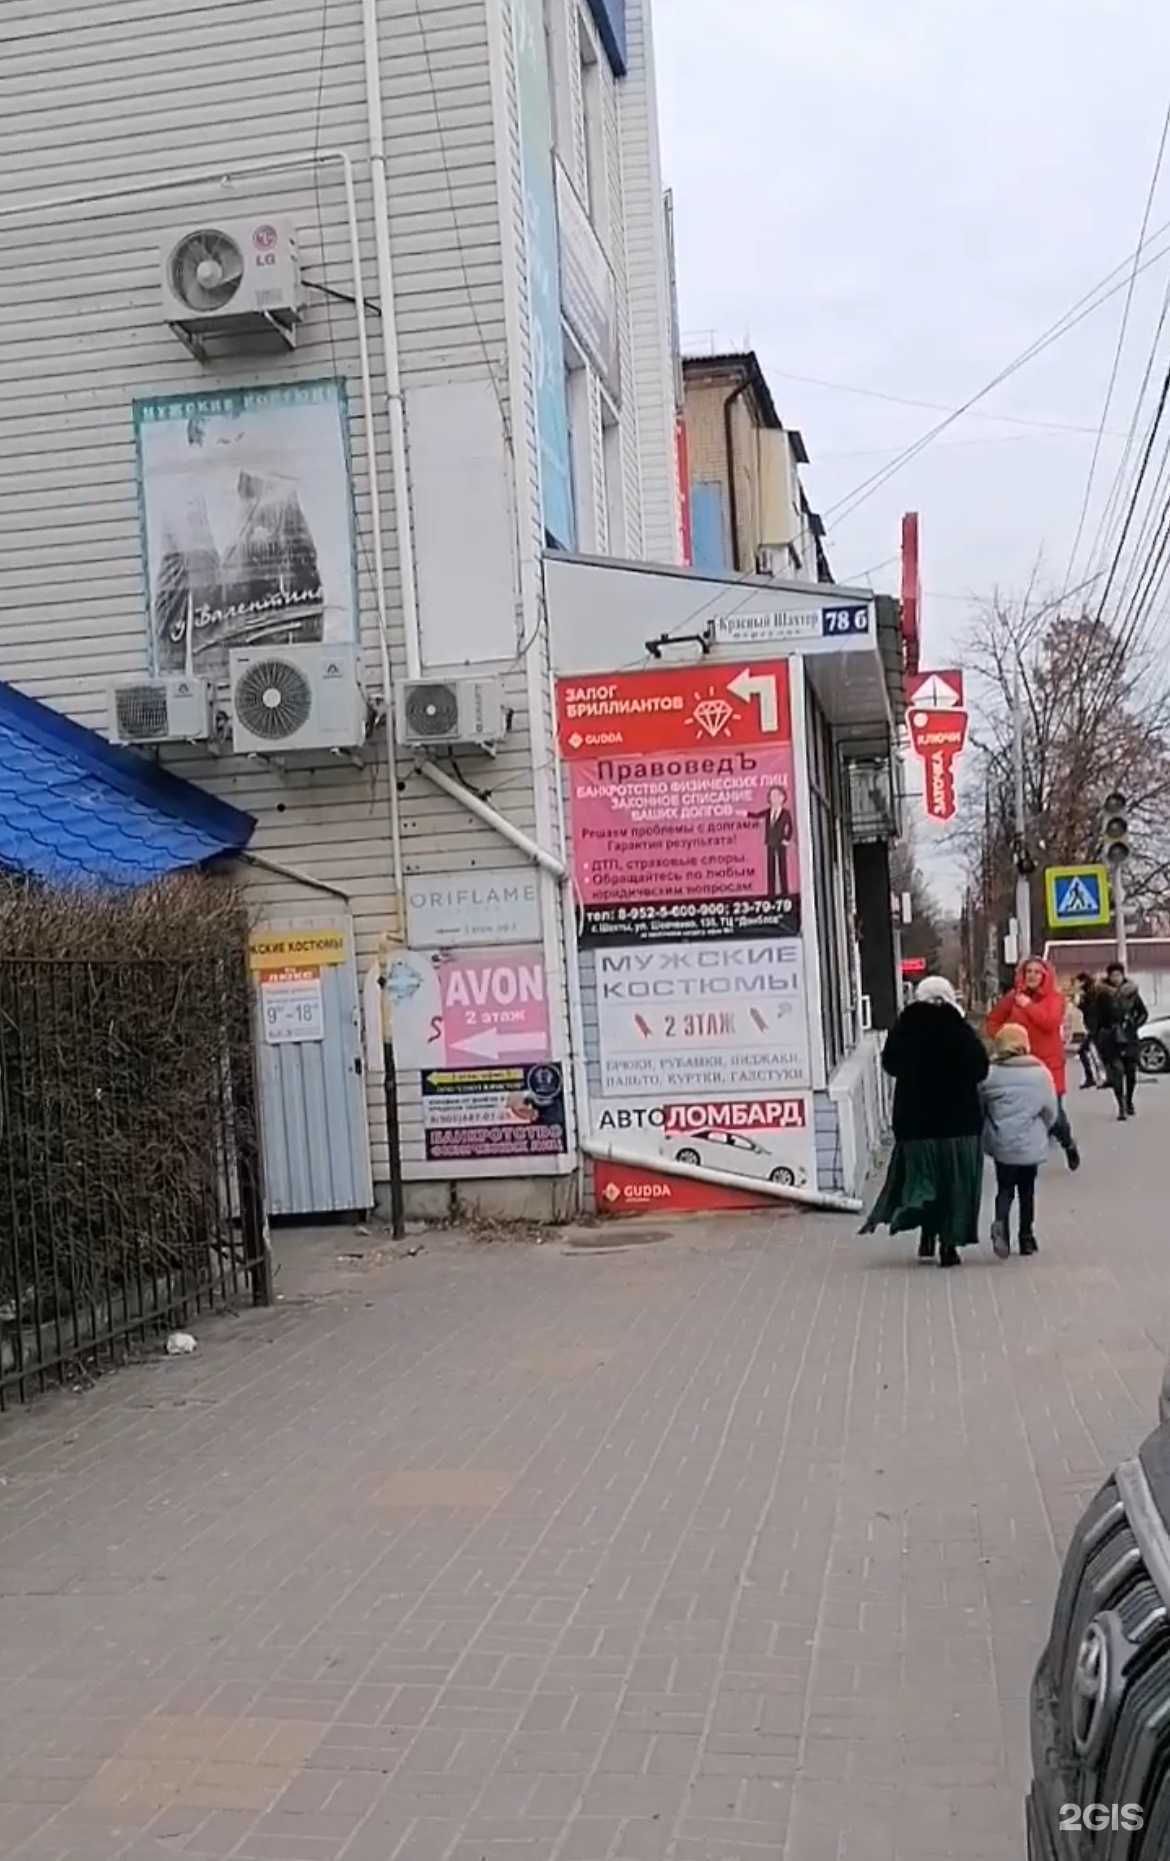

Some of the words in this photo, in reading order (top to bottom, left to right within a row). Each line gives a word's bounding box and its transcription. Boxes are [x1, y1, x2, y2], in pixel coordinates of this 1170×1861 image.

[143, 399, 233, 418] МУЖСКИЕ
[719, 615, 770, 633] Красный
[774, 612, 818, 632] Шахтер
[826, 610, 849, 631] 78
[565, 685, 617, 702] ЗАЛОГ
[566, 696, 684, 718] БРИЛЛИАНТОВ
[585, 732, 622, 745] GUDDA
[917, 732, 961, 746] КЛЮЧИ
[597, 752, 757, 783] ПравоведЪ
[576, 781, 668, 798] БАНКРОТСТВО
[670, 776, 758, 793] ФИЗИЧЕСКИХ
[760, 774, 788, 788] ЛИЦ
[611, 794, 680, 810] ЗАКОННОЕ
[682, 788, 753, 806] СПИСАНИЕ
[631, 806, 679, 822] ВАШИХ
[681, 803, 733, 819] ДОЛГОВ
[582, 826, 628, 840] Решаем
[630, 822, 695, 838] проблемы
[707, 820, 760, 834] долгами
[607, 838, 664, 853] Гарантия
[626, 856, 699, 872] страховые
[592, 872, 683, 888] Обращайтесь
[686, 869, 703, 882] по
[706, 866, 756, 879] любым
[410, 885, 536, 909] ORIFLAME
[592, 886, 684, 900] юридическим
[288, 938, 344, 953] КОСТЮМЫ
[602, 945, 798, 972] МУЖСКИЕ
[446, 965, 544, 1006] AVON
[603, 973, 798, 998] КОСТЮМЫ
[465, 1010, 477, 1025] 2
[482, 1009, 526, 1024] этаж
[664, 1016, 676, 1037] 2
[684, 1012, 736, 1036] ЭТАЖ
[606, 1058, 656, 1072] БРЮКИ,
[660, 1054, 727, 1070] РУБАШКИ,
[668, 1072, 726, 1085] КУРТКИ,
[730, 1068, 804, 1082] ГАЛСТУКИ
[599, 1101, 803, 1131] АВТОЛОМБАРД
[624, 1184, 672, 1198] GUDDA
